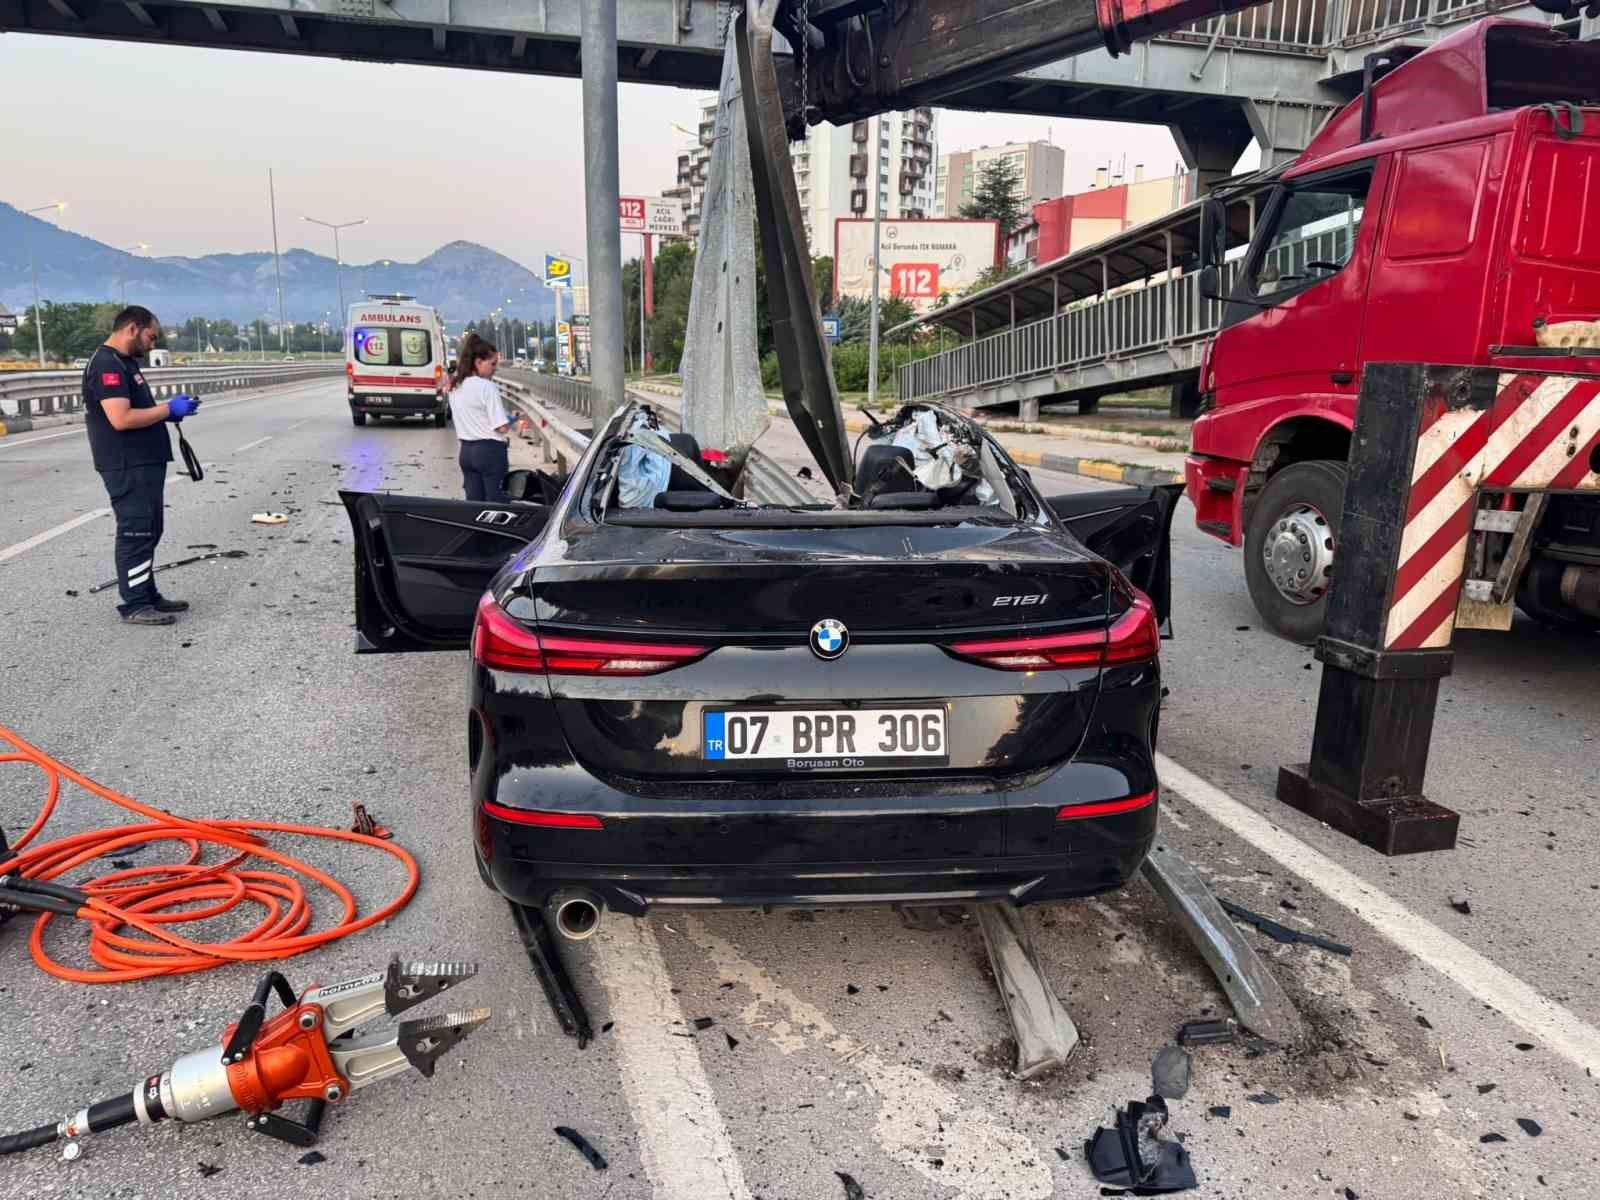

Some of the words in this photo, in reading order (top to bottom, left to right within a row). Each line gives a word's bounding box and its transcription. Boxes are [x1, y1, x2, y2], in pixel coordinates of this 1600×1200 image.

[619, 201, 641, 217] 112
[898, 269, 932, 294] 112
[360, 313, 422, 324] AMBULANS
[369, 342, 384, 350] 112
[727, 716, 769, 754] 07
[792, 714, 856, 753] BPR
[878, 714, 941, 752] 306
[708, 739, 723, 751] TR
[786, 758, 838, 768] Borusan
[842, 757, 865, 767] Oto
